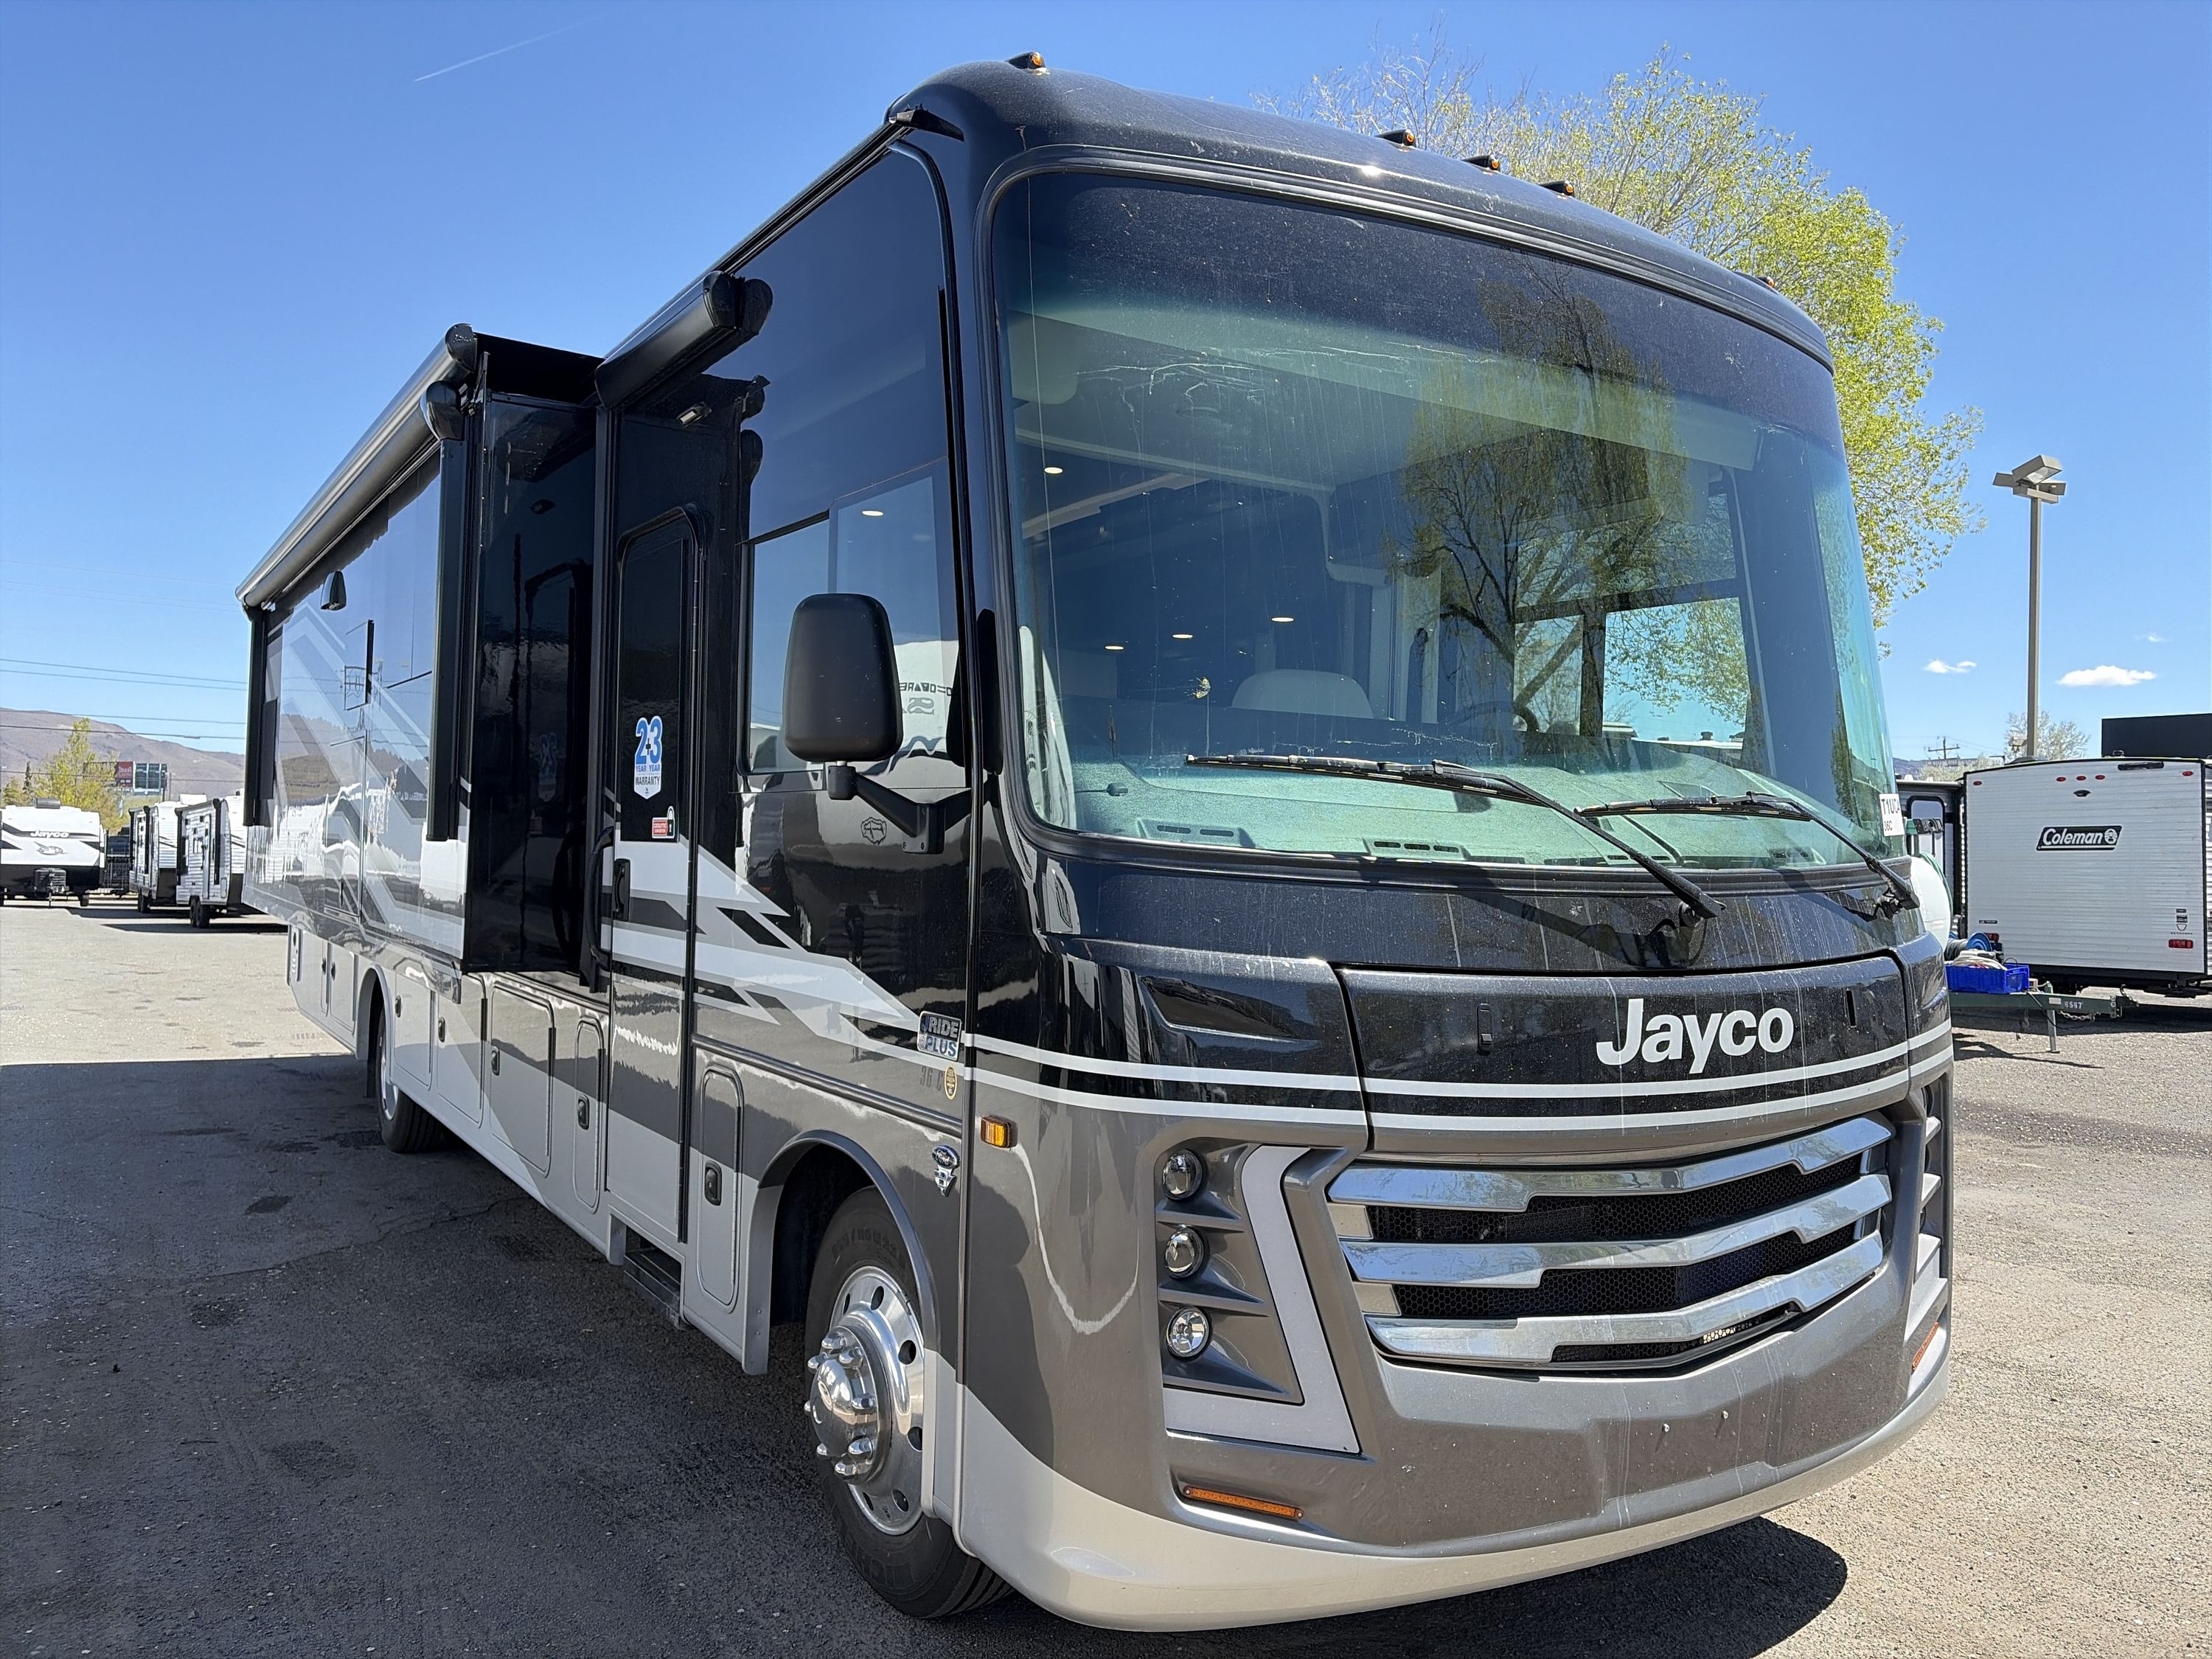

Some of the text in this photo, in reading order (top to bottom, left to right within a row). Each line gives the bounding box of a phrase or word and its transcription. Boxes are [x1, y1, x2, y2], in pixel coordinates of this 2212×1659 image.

[635, 776, 661, 785] WARRANTY
[30, 829, 69, 839] Jayco
[2042, 828, 2104, 846] Coleman
[1596, 998, 1794, 1074] Jayco
[925, 1035, 956, 1057] PLUS
